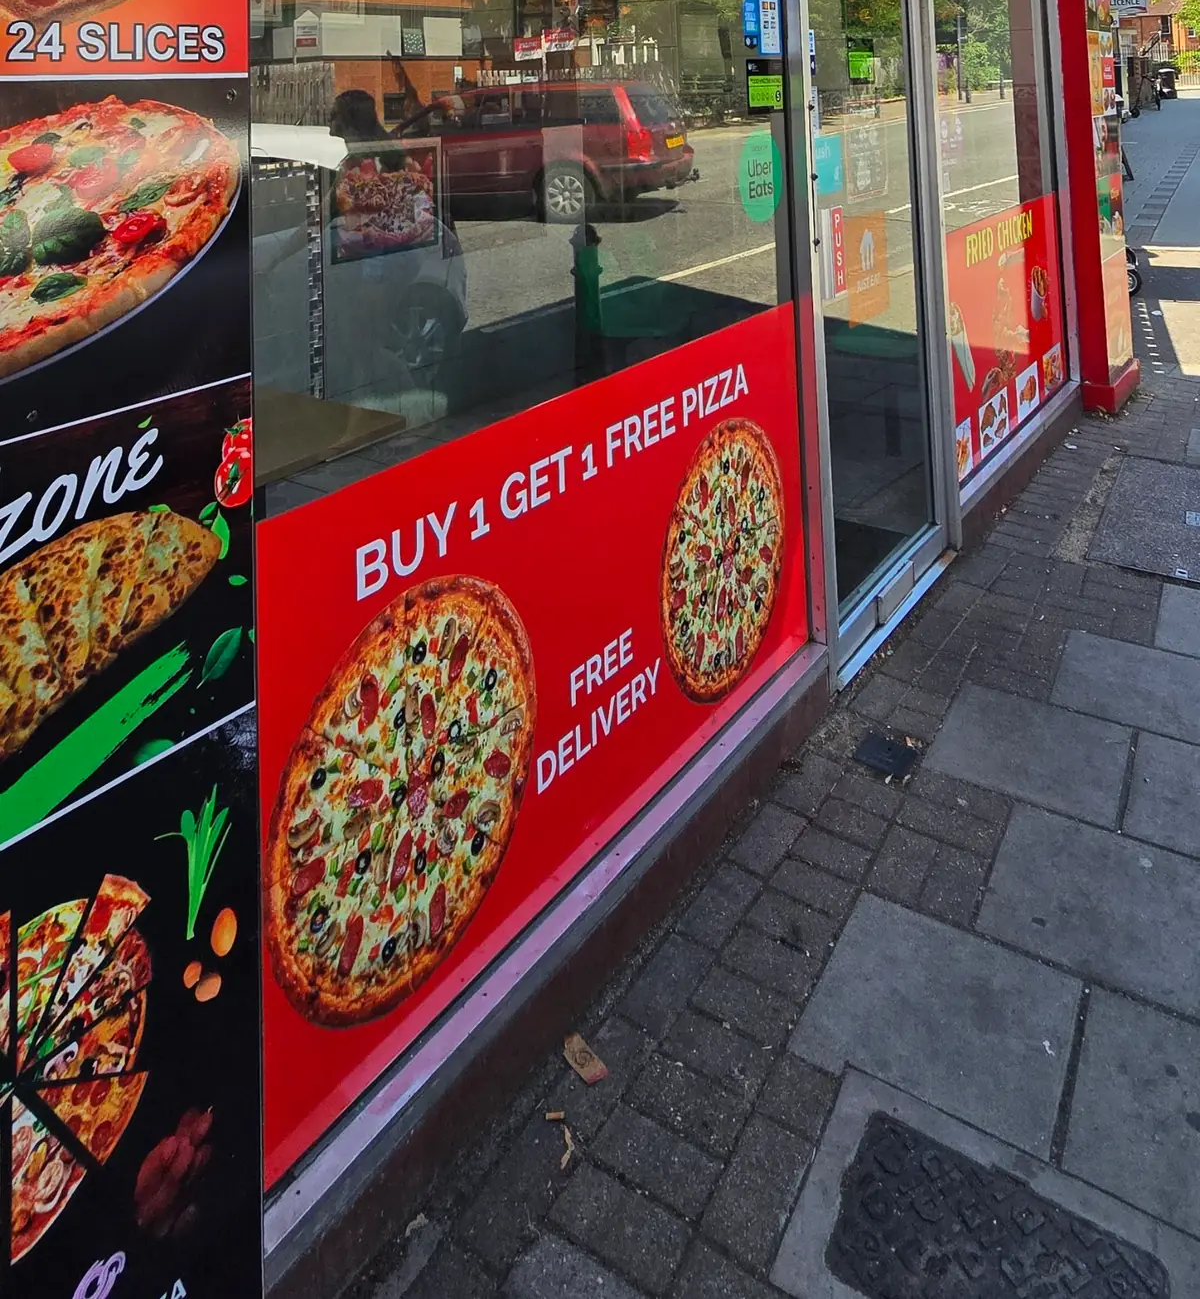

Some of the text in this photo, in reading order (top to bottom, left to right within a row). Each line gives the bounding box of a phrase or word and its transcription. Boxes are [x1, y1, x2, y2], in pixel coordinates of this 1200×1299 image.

[5, 20, 227, 62] 24 SLICES
[747, 159, 773, 178] Uber
[814, 143, 831, 160] ush
[749, 181, 774, 199] Eats
[834, 213, 845, 287] PUSH
[966, 209, 1033, 268] FRIED CHICKEN
[355, 363, 749, 601] BUY 1 GET 1 FREE PIZZA
[569, 627, 634, 708] FREE
[535, 658, 661, 796] DELIVERY
